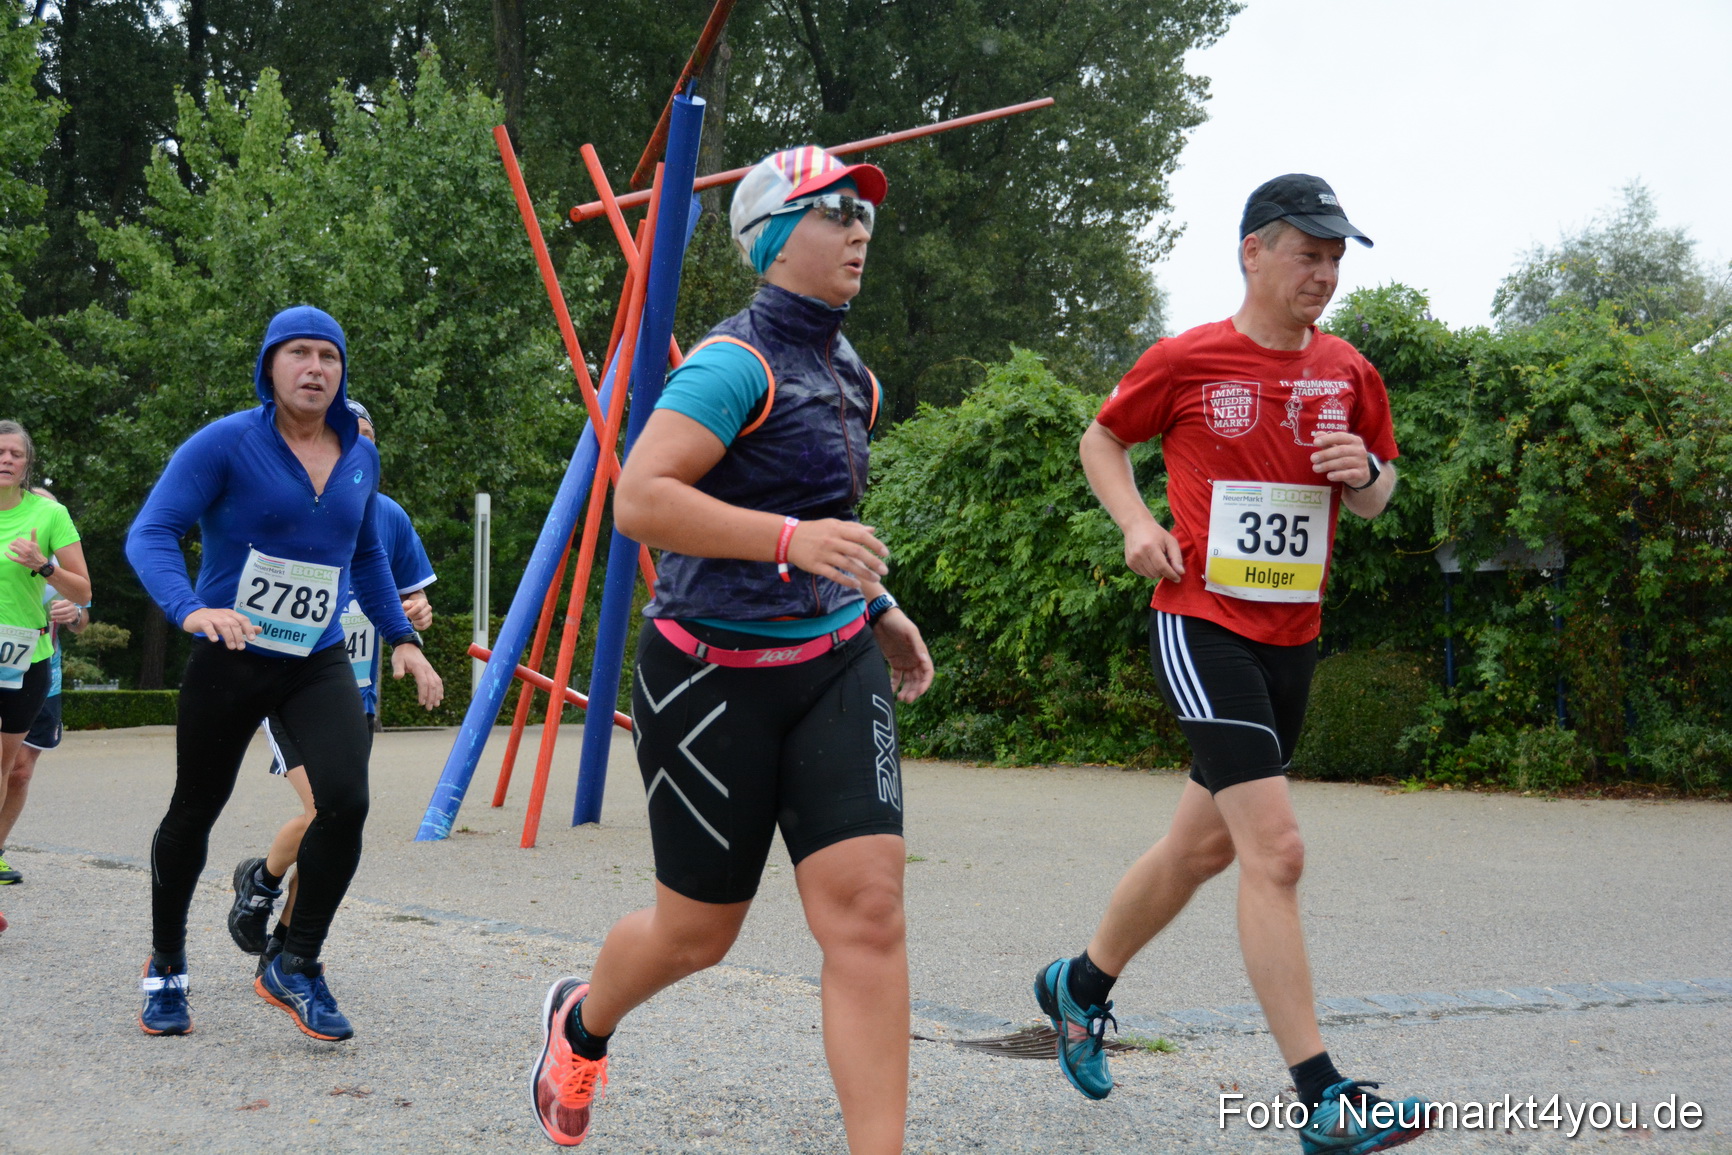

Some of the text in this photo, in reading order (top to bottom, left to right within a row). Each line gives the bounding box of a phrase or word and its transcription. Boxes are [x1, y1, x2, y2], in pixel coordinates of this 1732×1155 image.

[1279, 380, 1349, 389] 11. NEUMARKTER
[1292, 387, 1340, 396] STADTLAUF
[1211, 388, 1250, 398] IMMER
[1210, 397, 1252, 407] WIEDER
[1213, 405, 1249, 419] NEU
[1213, 418, 1250, 428] MARKT
[1222, 494, 1263, 503] NeuerMarkt
[1270, 487, 1322, 504] BOCK
[1236, 511, 1310, 557] 335
[1213, 548, 1219, 556] D
[253, 562, 285, 576] NeuerMarkt
[290, 564, 333, 582] BOCK
[1244, 566, 1295, 588] Holger
[246, 576, 330, 623] 2783
[258, 620, 307, 643] Werner
[872, 694, 901, 811] 2XU
